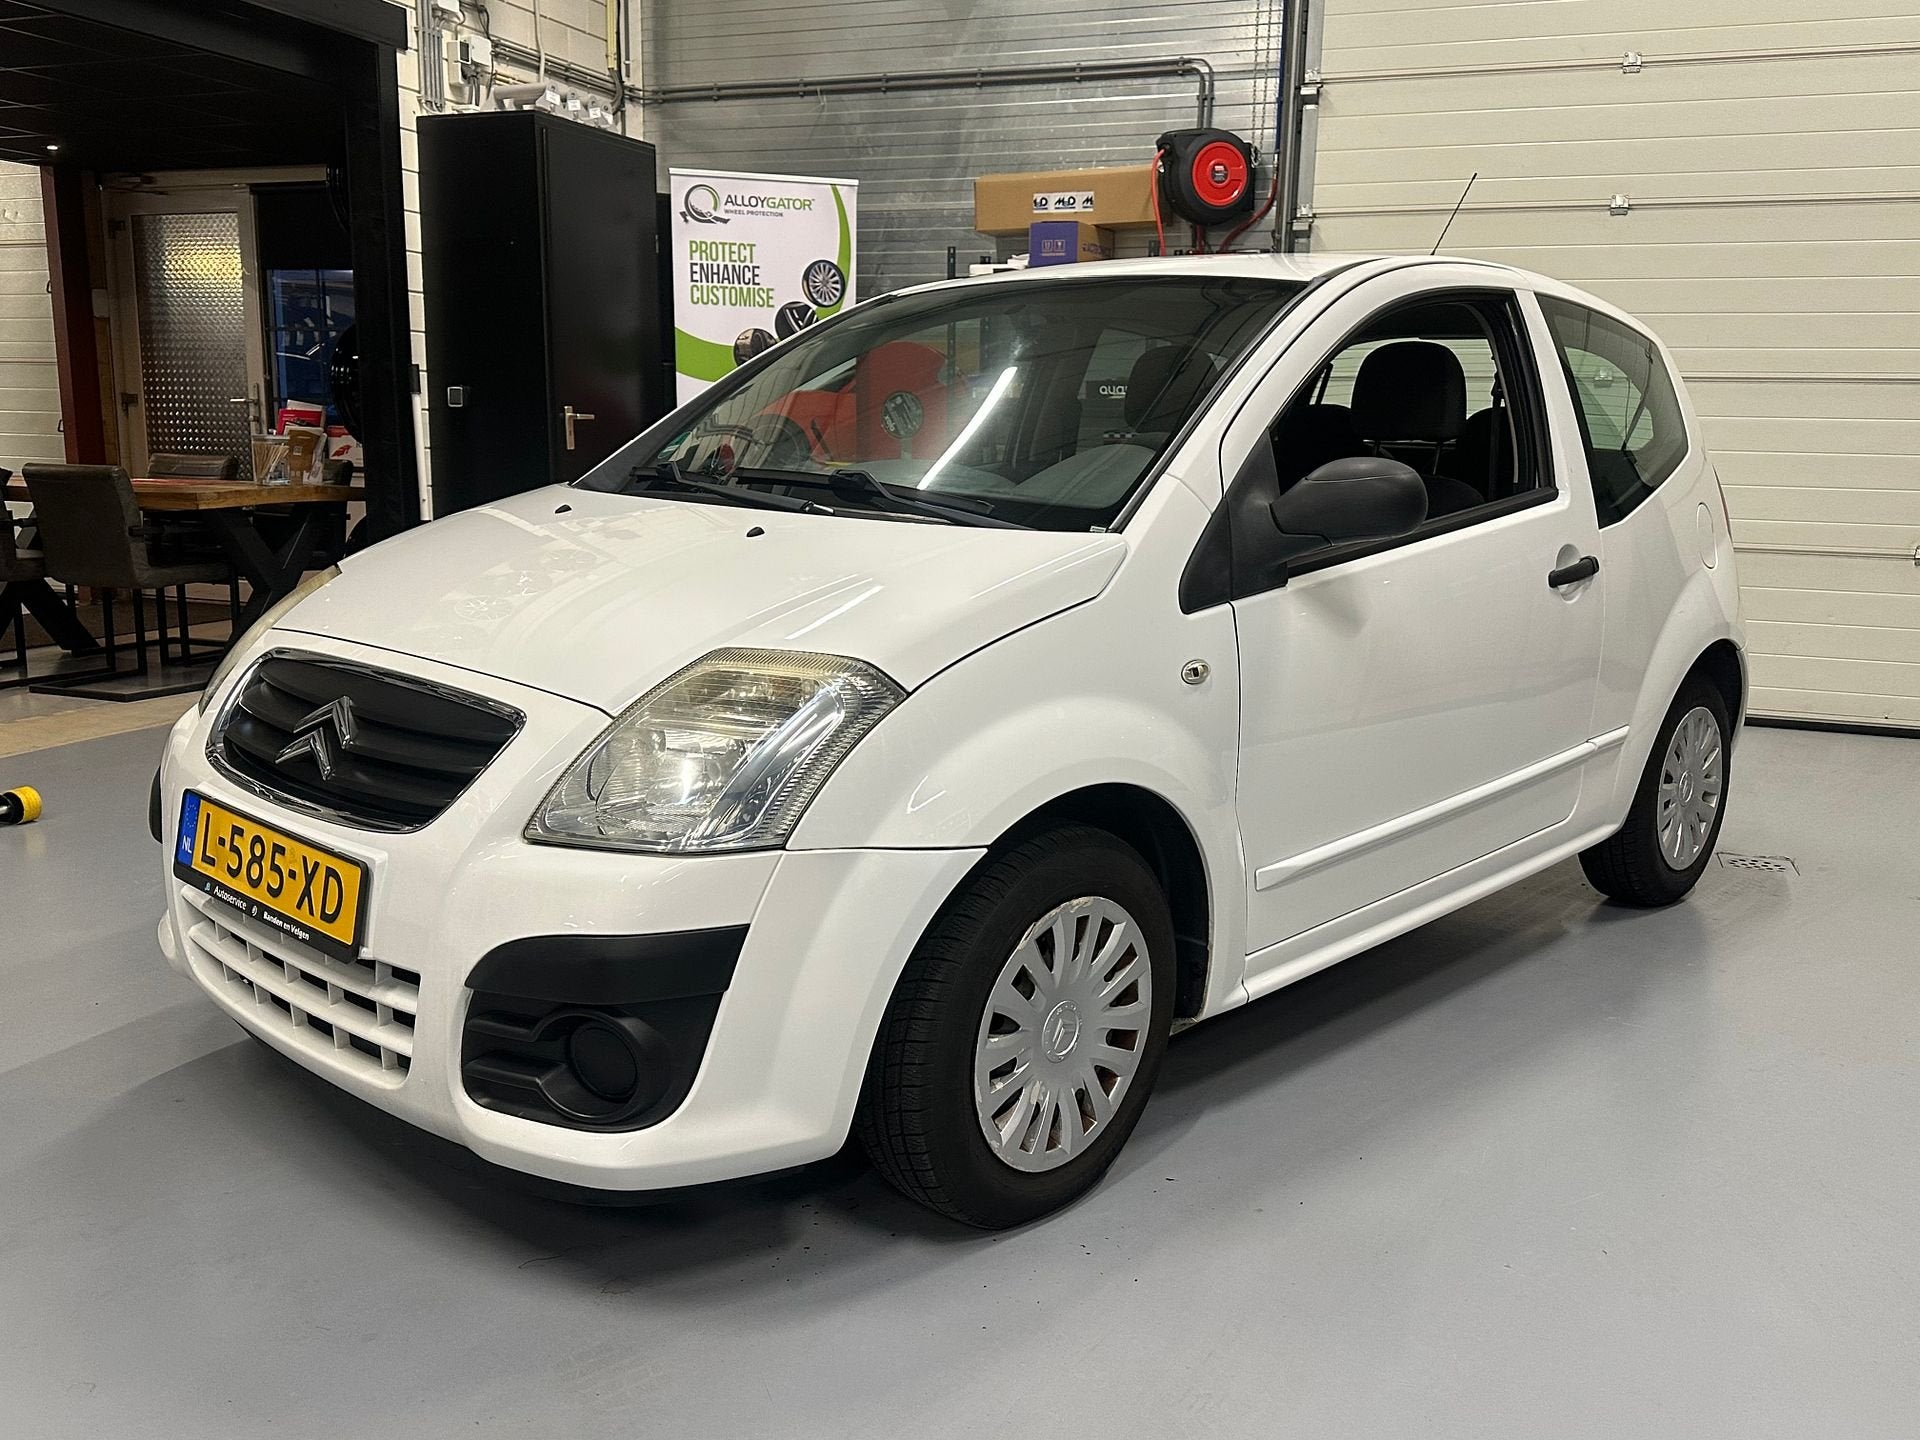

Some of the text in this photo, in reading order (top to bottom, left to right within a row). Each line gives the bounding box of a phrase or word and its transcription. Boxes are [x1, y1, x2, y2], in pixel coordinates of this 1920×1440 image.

[724, 194, 812, 211] ALLOYGATOR
[746, 210, 784, 218] PROTECTION
[689, 240, 756, 264] PROTECT
[690, 263, 761, 286] ENHANCE
[690, 285, 775, 308] CUSTOMISE
[181, 835, 193, 854] NL
[200, 812, 344, 925] L-585-XD
[213, 885, 247, 911] Autoservice
[263, 911, 310, 941] Banden en Velgen
